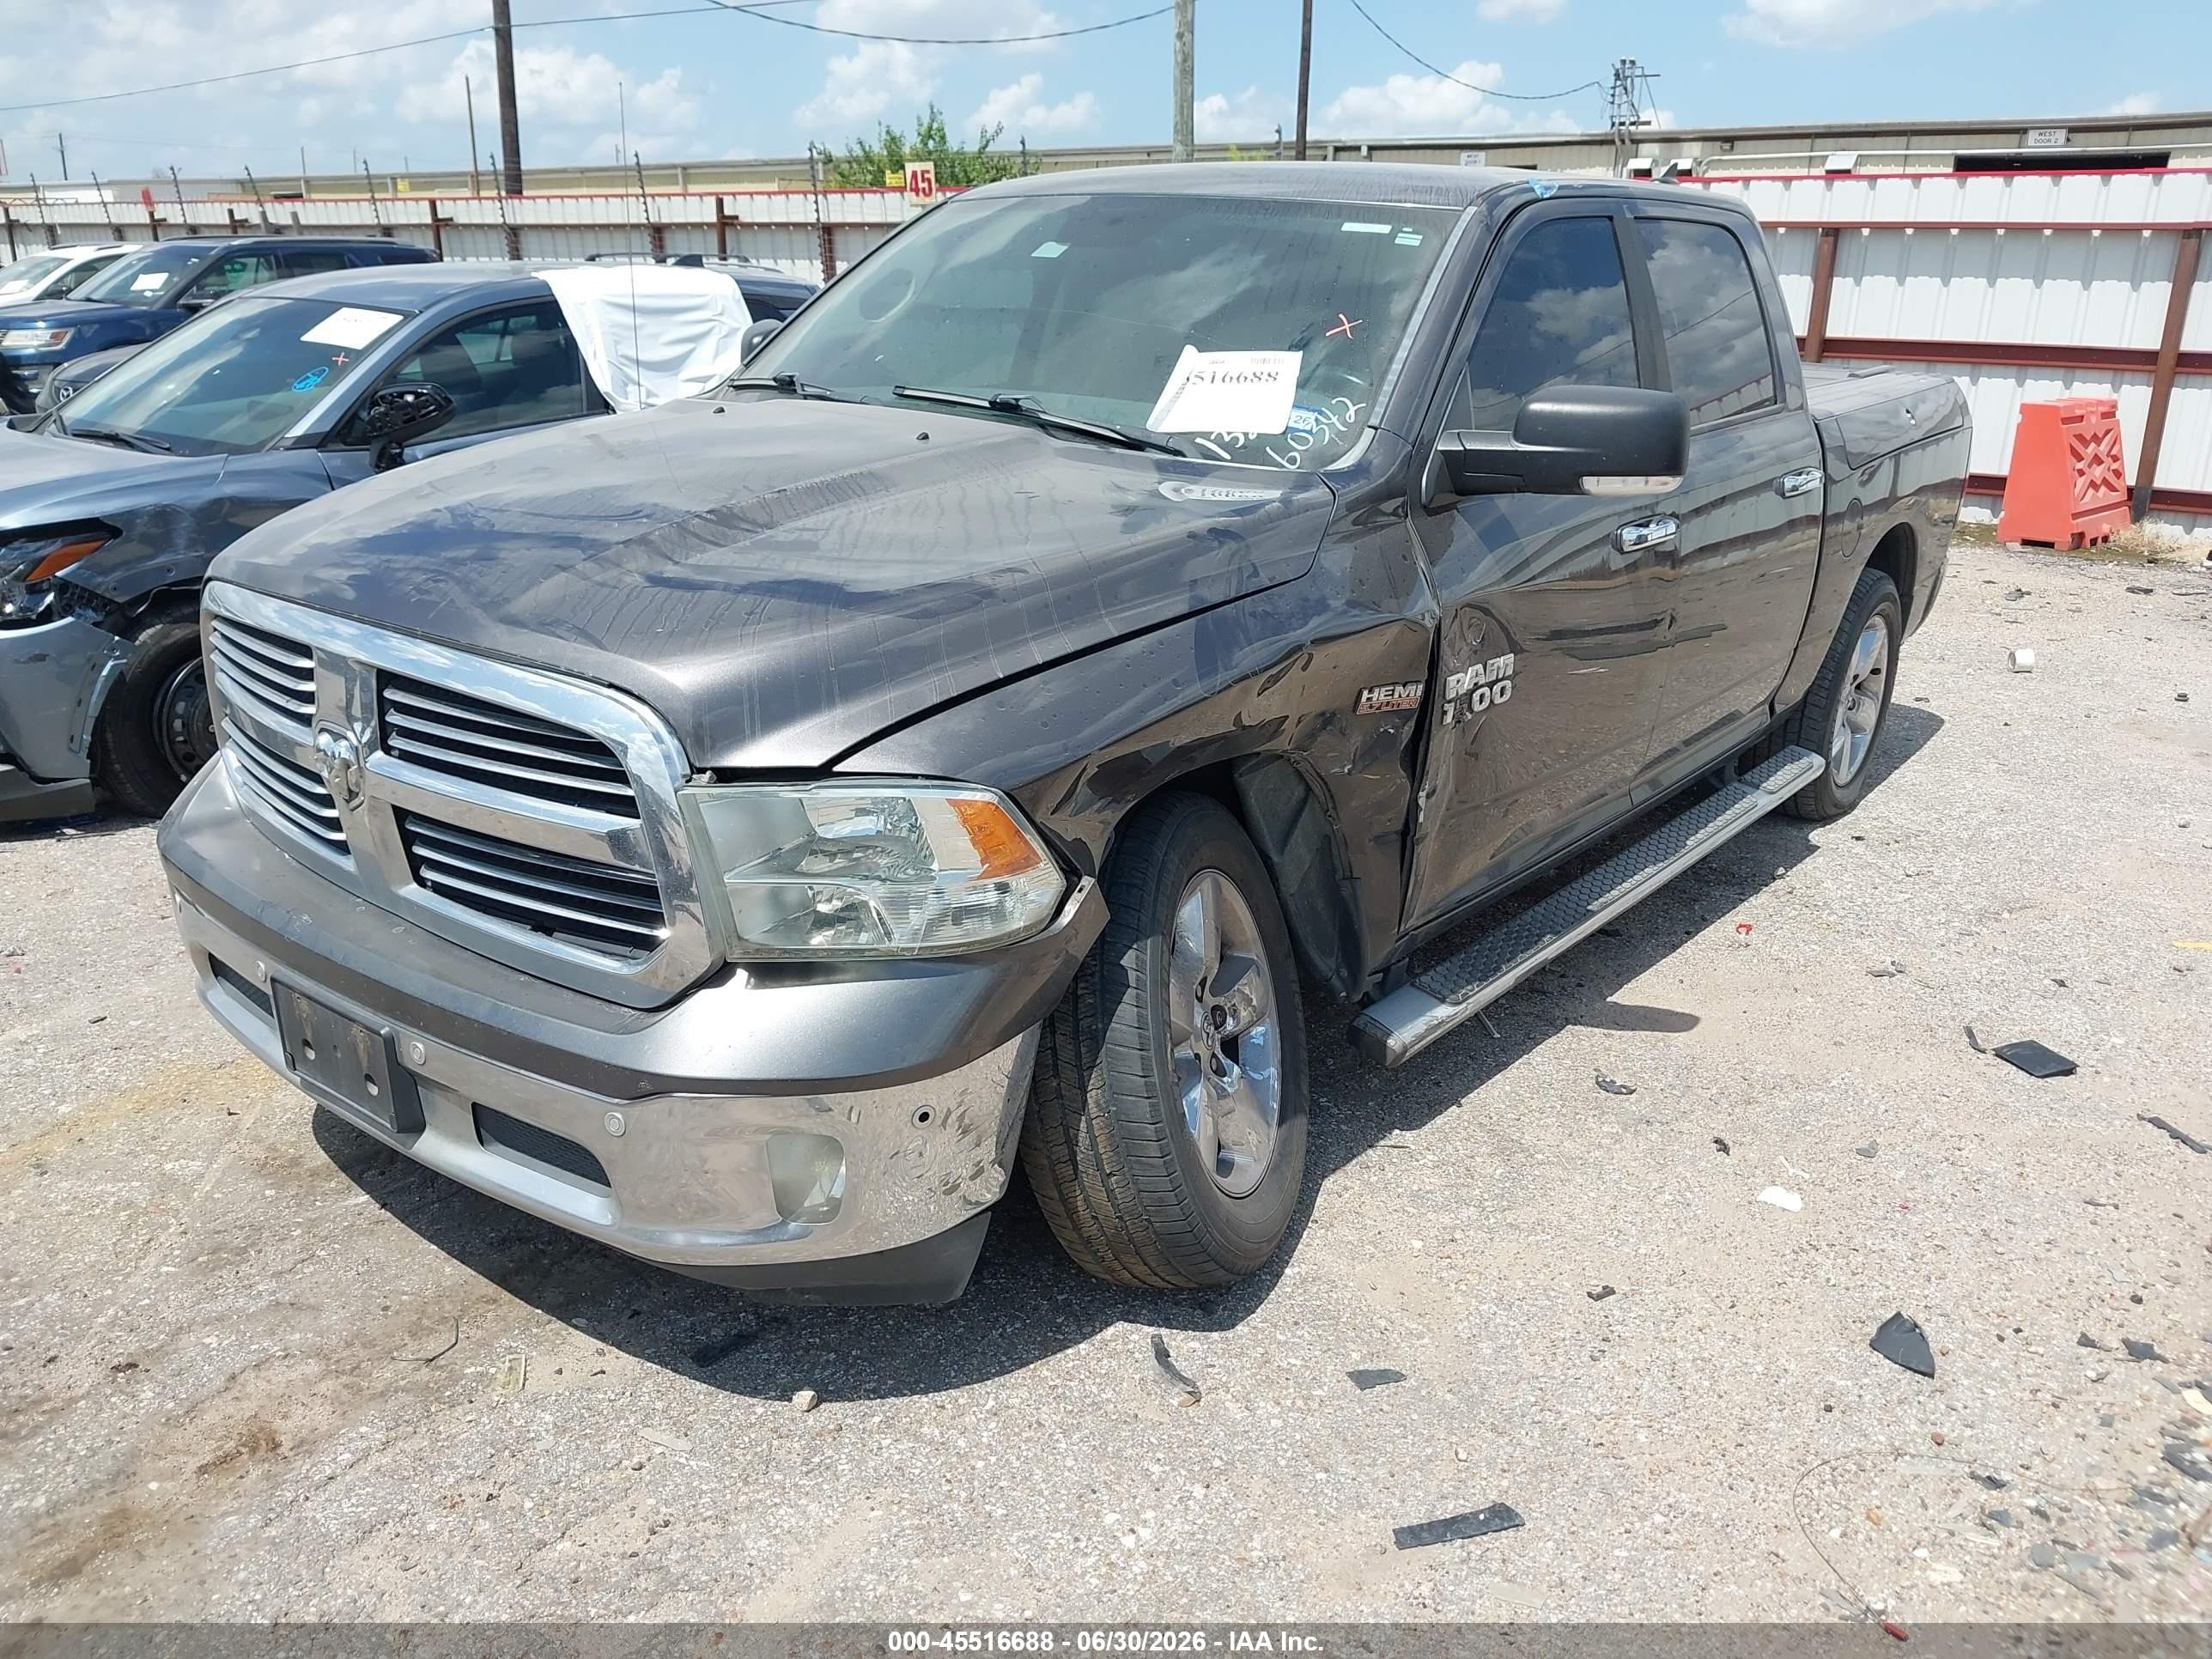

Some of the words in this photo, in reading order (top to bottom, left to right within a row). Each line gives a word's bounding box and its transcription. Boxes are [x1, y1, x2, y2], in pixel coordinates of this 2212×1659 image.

[910, 170, 933, 198] 45
[1194, 429, 1258, 460] 13
[1446, 652, 1515, 701] RAM
[1360, 682, 1424, 703] HEMI
